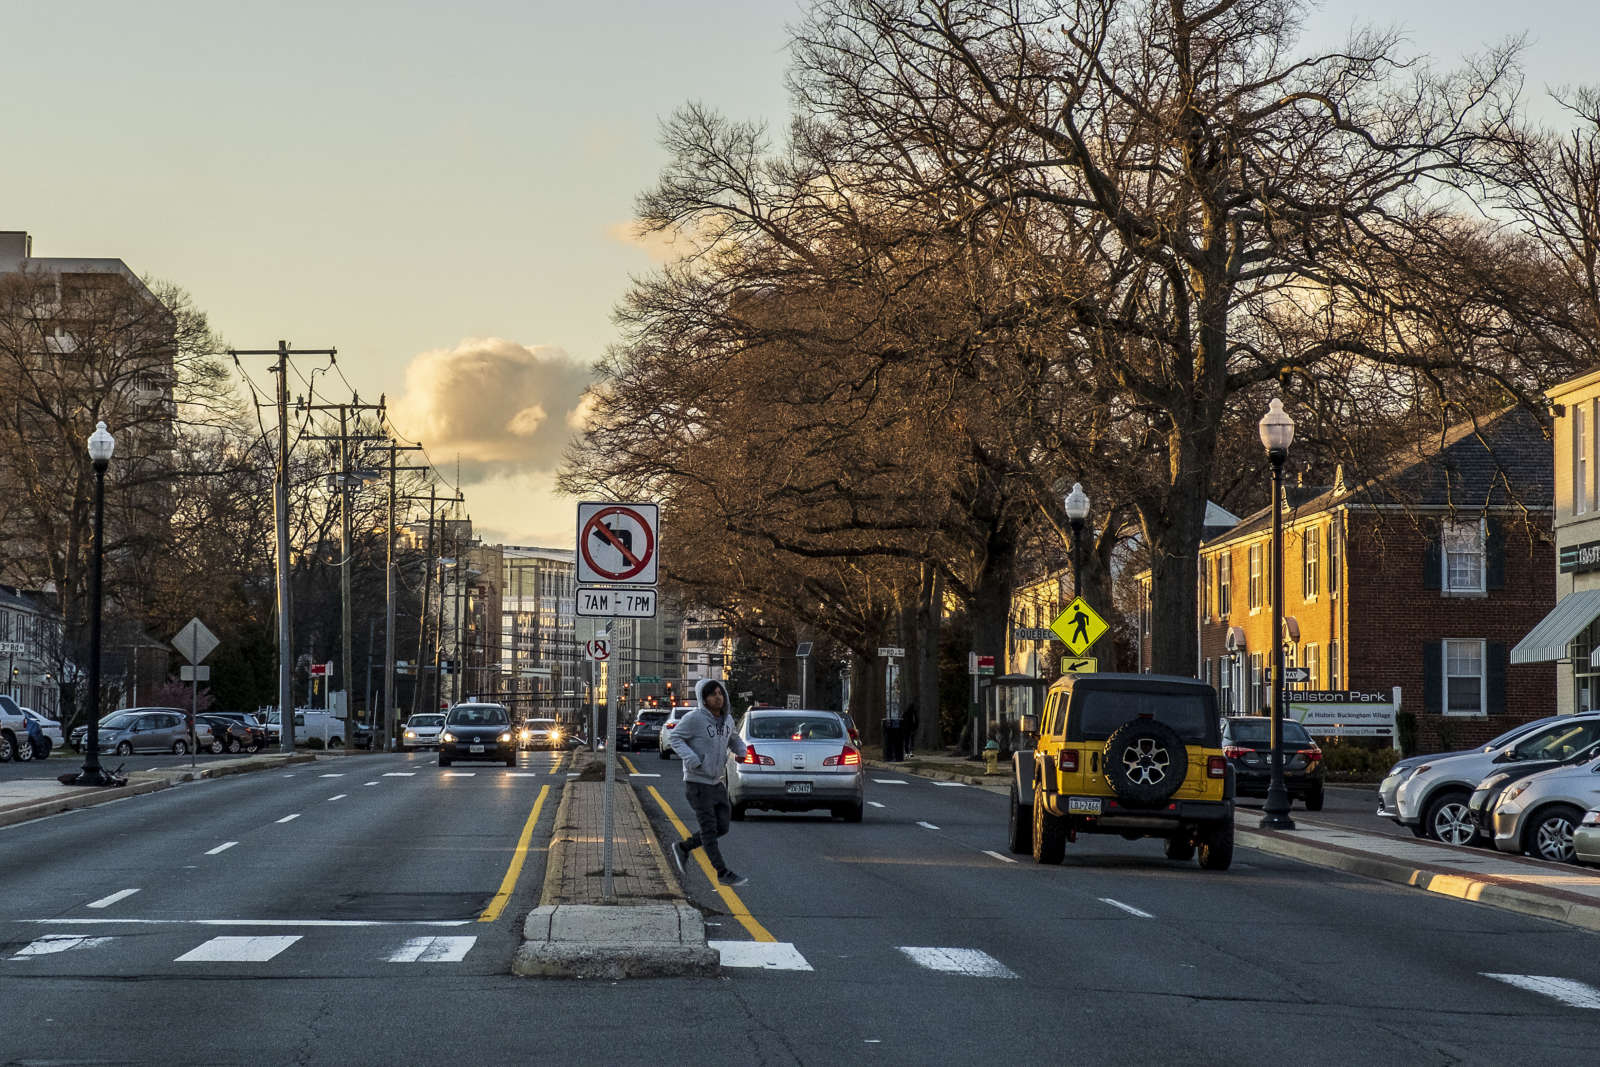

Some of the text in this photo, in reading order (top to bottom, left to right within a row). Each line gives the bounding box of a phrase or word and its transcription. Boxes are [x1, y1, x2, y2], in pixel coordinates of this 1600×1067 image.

[585, 595, 608, 610] 7AM
[1020, 629, 1054, 639] QUEBEC
[1282, 691, 1386, 702] Ballston Park
[1337, 712, 1371, 720] Buckingham
[1372, 712, 1391, 720] Village
